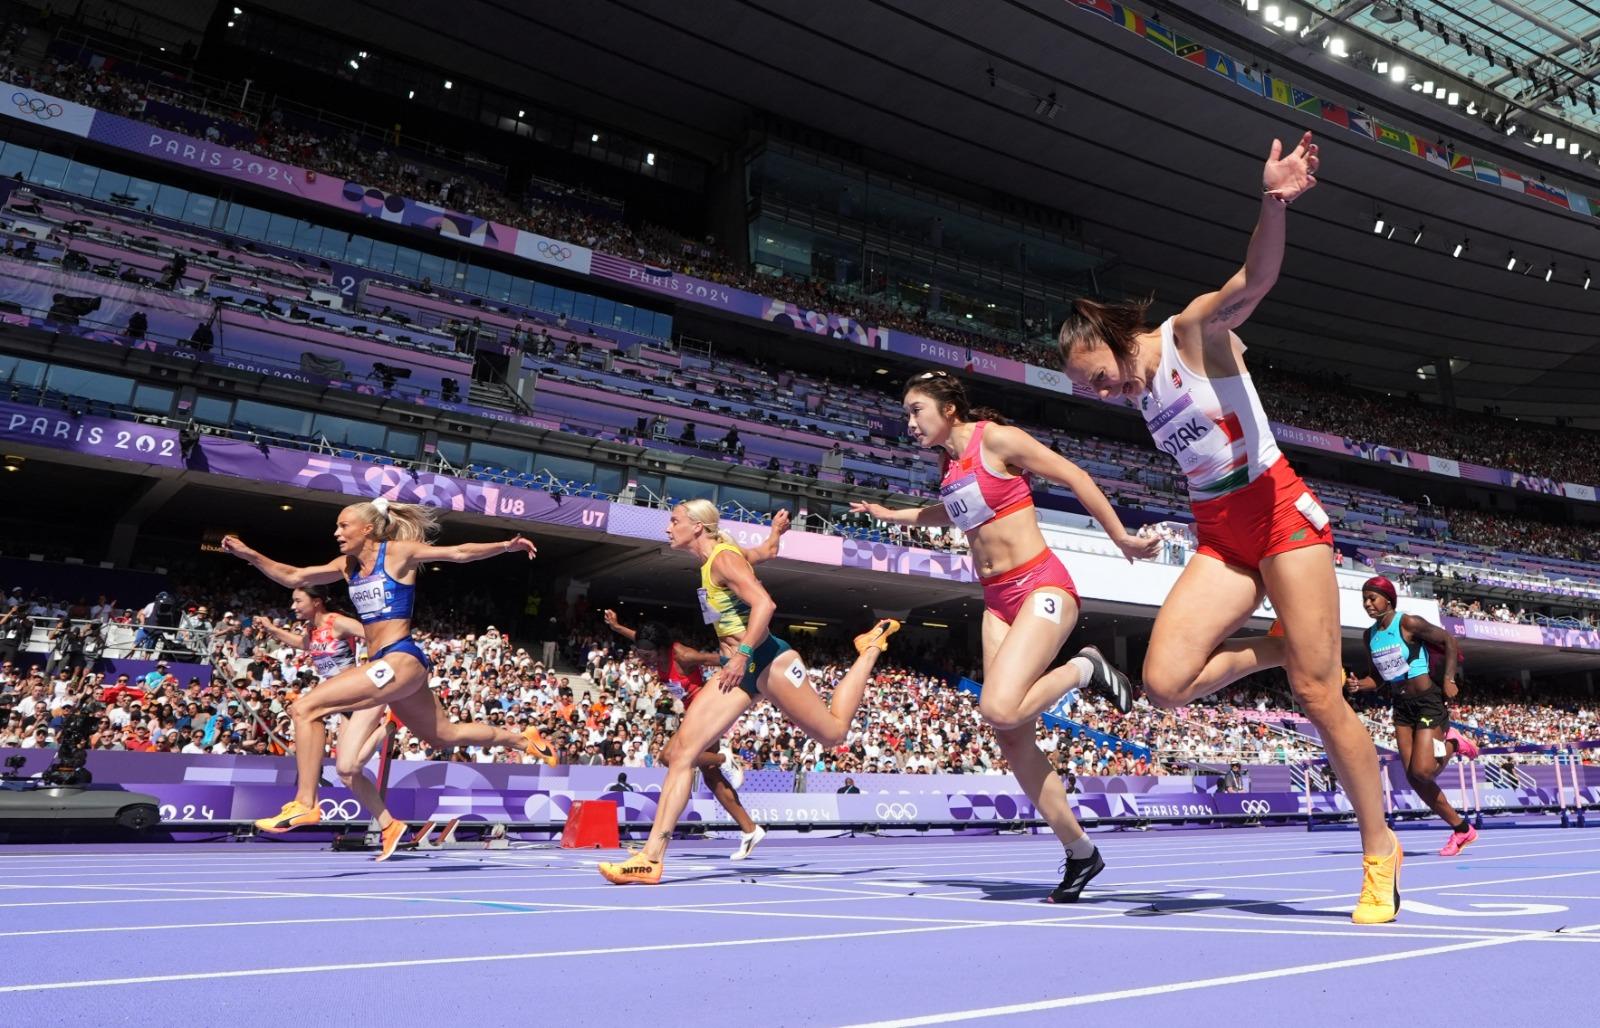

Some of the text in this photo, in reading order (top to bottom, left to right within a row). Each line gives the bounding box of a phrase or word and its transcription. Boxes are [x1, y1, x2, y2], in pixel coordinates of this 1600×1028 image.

[149, 134, 293, 185] PARIS 2024
[340, 276, 355, 295] 2
[686, 282, 728, 303] 2024
[920, 343, 997, 370] PARIS 024
[8, 414, 175, 457] PARIS 202
[1158, 417, 1208, 456] OZAK
[1277, 427, 1304, 441] PARIS
[500, 497, 525, 515] U8
[947, 499, 968, 518] WU
[582, 510, 605, 527] U7
[352, 588, 382, 602] ARALA
[1044, 598, 1055, 614] 3
[375, 668, 386, 679] 6
[791, 666, 802, 679] 5
[159, 804, 214, 820] 024
[785, 809, 831, 822] 2024
[1144, 805, 1214, 816] PARIS 2024
[622, 866, 652, 874] NITRO
